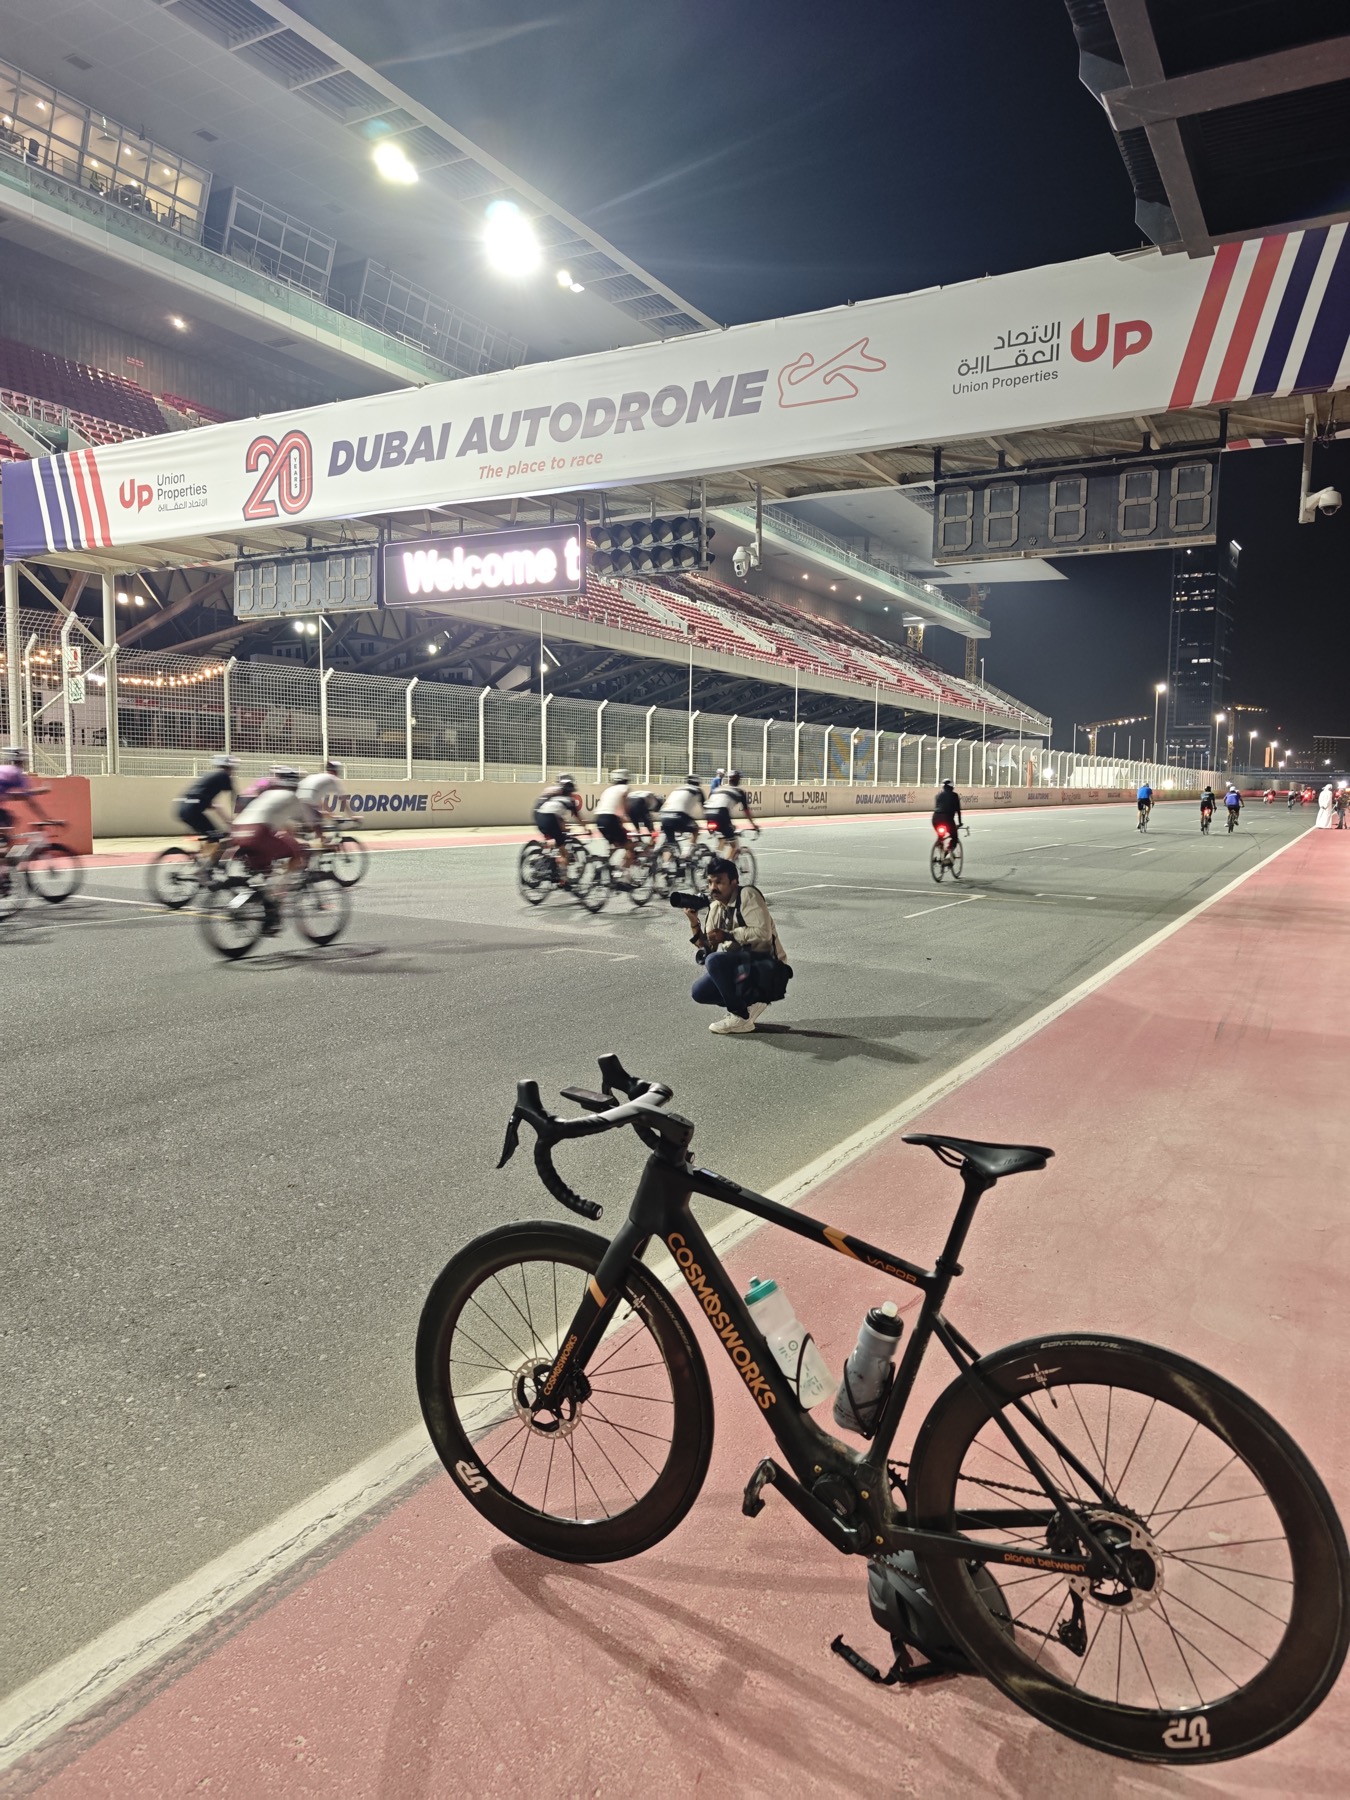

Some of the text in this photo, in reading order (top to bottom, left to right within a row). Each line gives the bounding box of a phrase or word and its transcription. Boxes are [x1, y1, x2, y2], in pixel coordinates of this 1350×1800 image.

[952, 369, 1059, 395] Union Properties
[327, 369, 769, 477] DUBAI AUTODROME
[243, 430, 313, 521] 20
[478, 452, 603, 480] The place to race
[157, 473, 185, 486] Union
[157, 484, 207, 501] Properties
[403, 547, 557, 594] Welcome
[321, 794, 429, 812] UTODROME
[856, 794, 874, 804] DUBAI
[866, 1255, 917, 1283] VAPOR
[1040, 1340, 1121, 1349] CONTINENTAL
[1004, 1553, 1085, 1572] planet between
